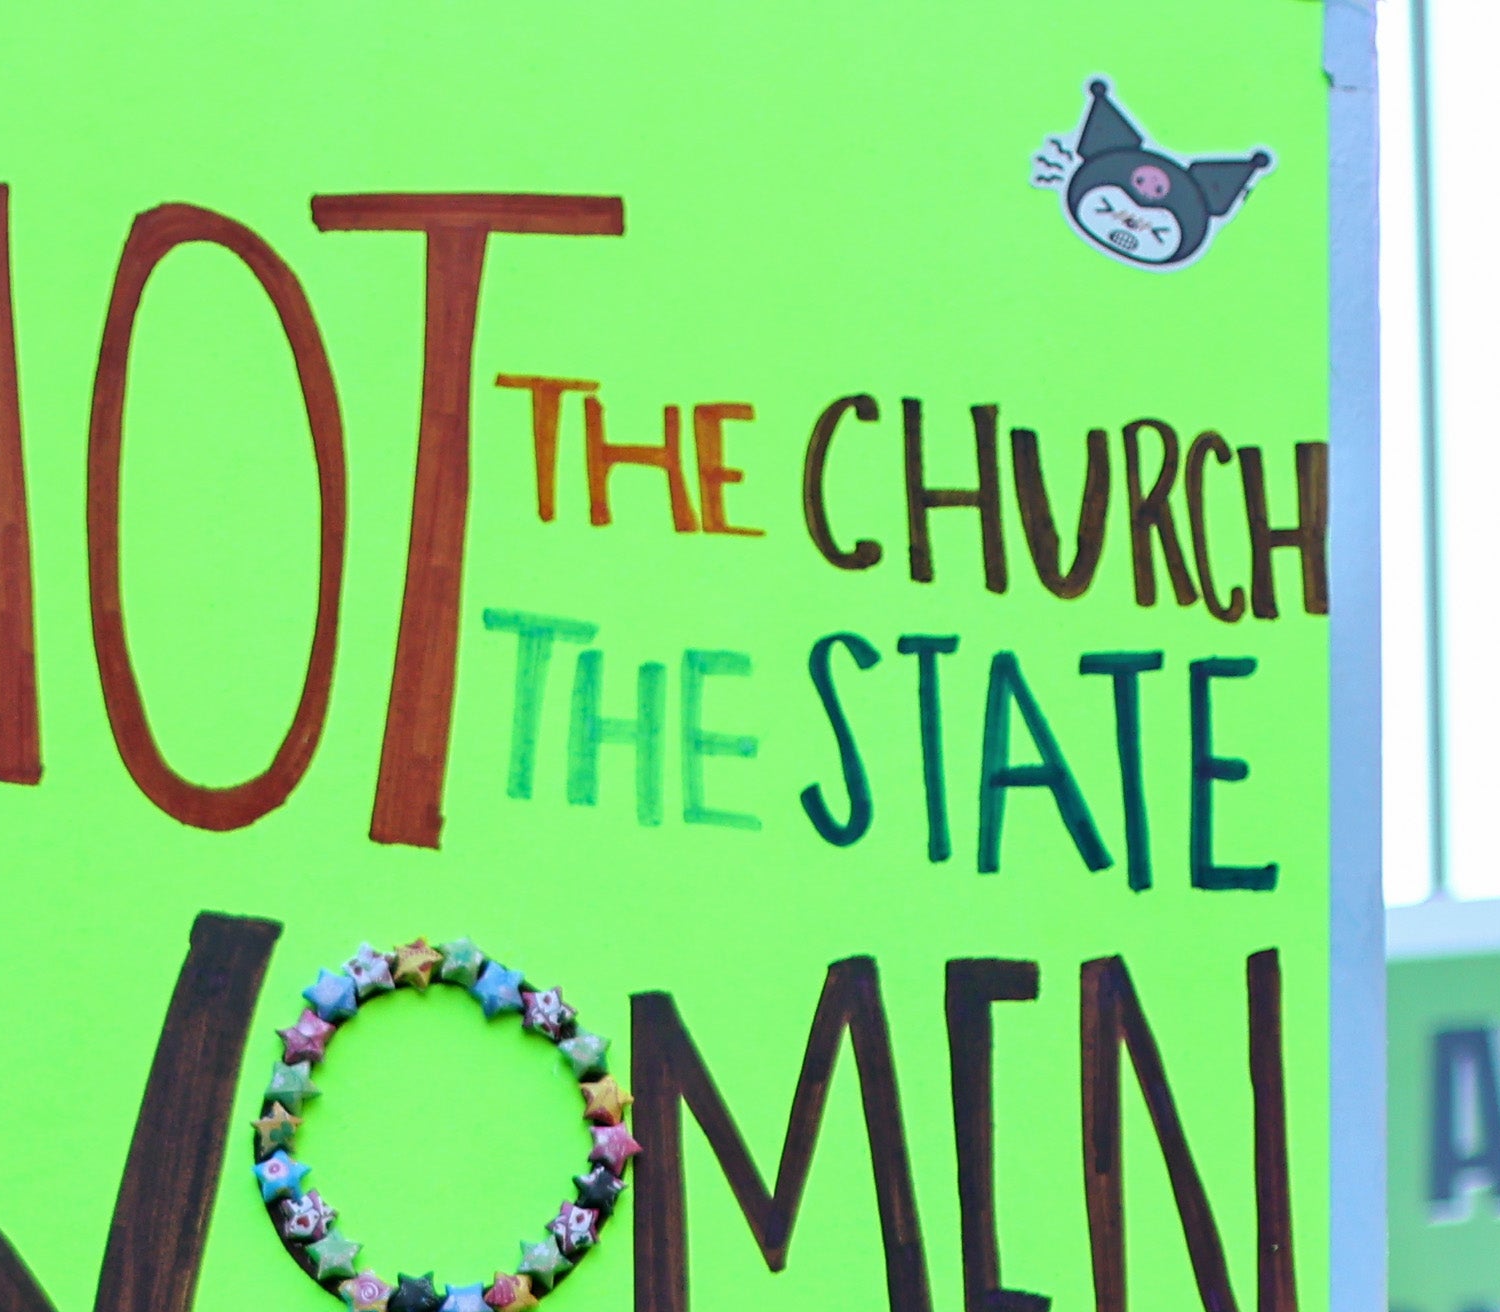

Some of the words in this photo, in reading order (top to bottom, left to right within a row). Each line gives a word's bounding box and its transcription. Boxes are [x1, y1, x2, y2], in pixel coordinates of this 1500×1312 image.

[495, 373, 765, 537] THE
[804, 395, 1330, 622] CHURCH
[483, 607, 762, 831] THE
[800, 633, 1278, 892] STATE
